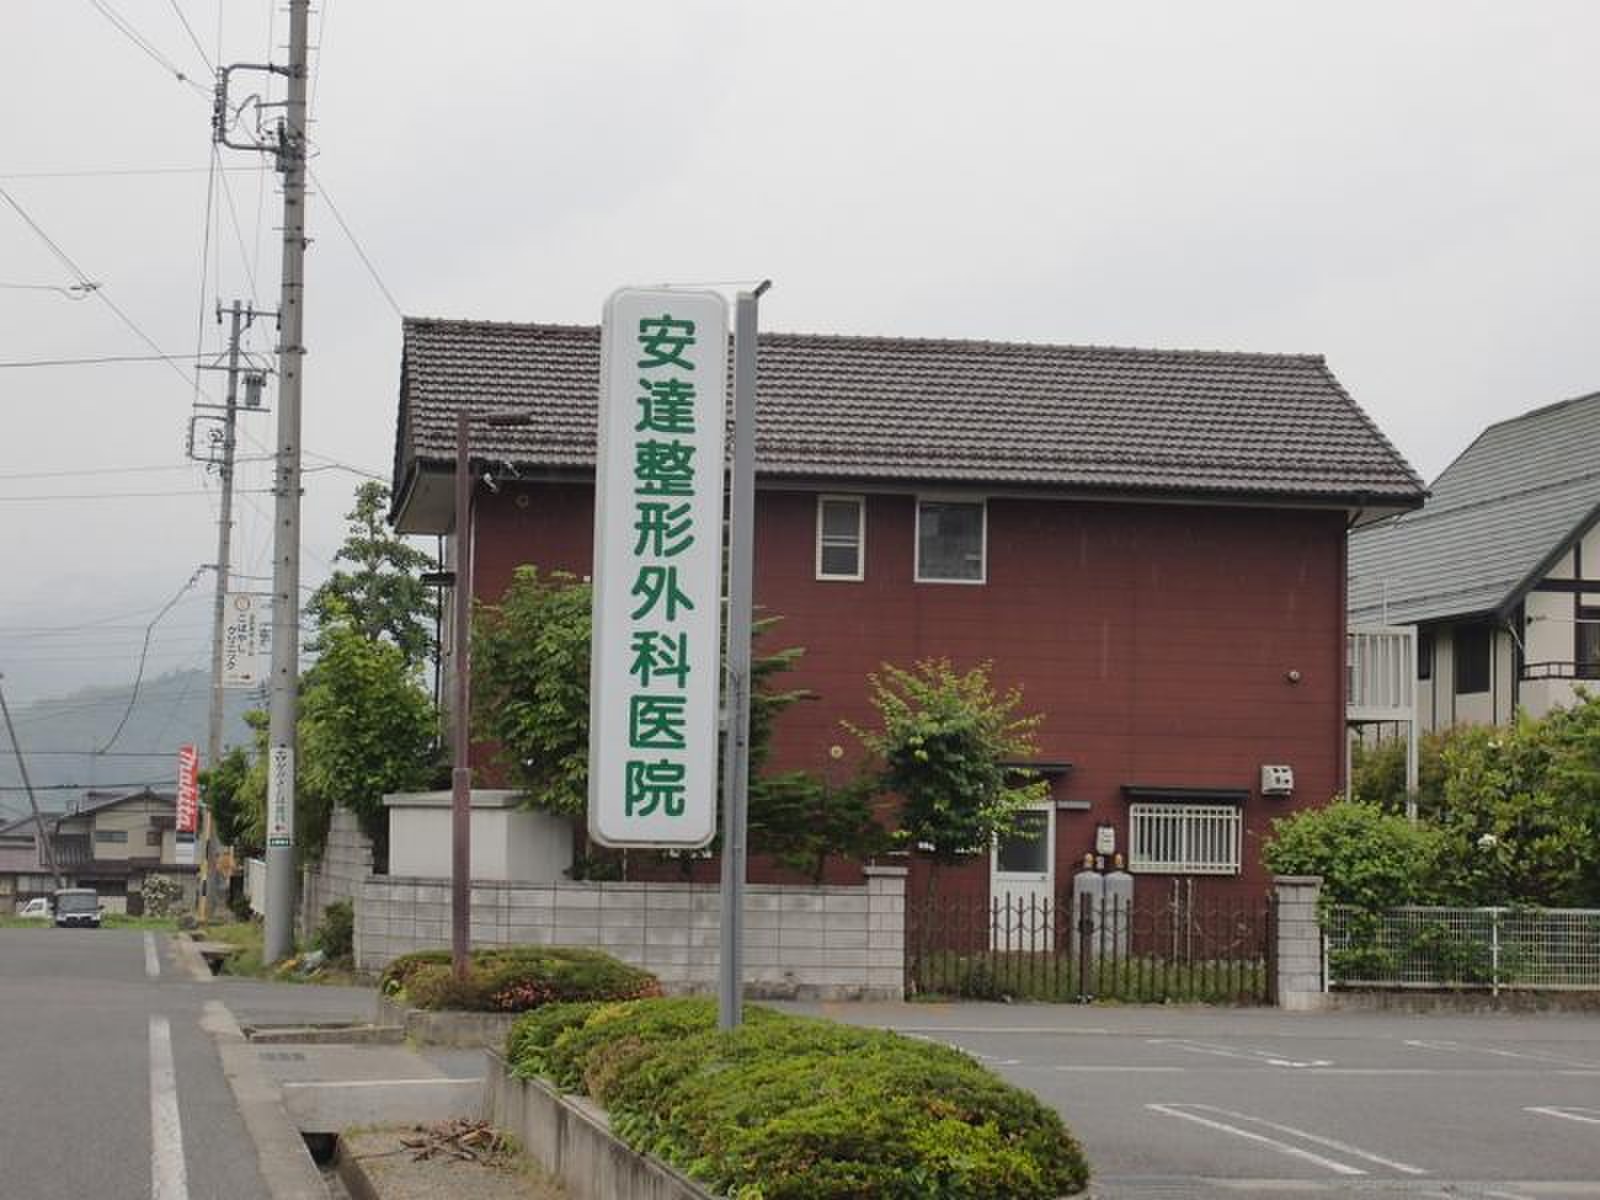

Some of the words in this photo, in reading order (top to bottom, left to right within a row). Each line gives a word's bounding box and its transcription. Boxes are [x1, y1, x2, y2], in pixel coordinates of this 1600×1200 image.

[625, 314, 696, 817] 安達整形外科医院
